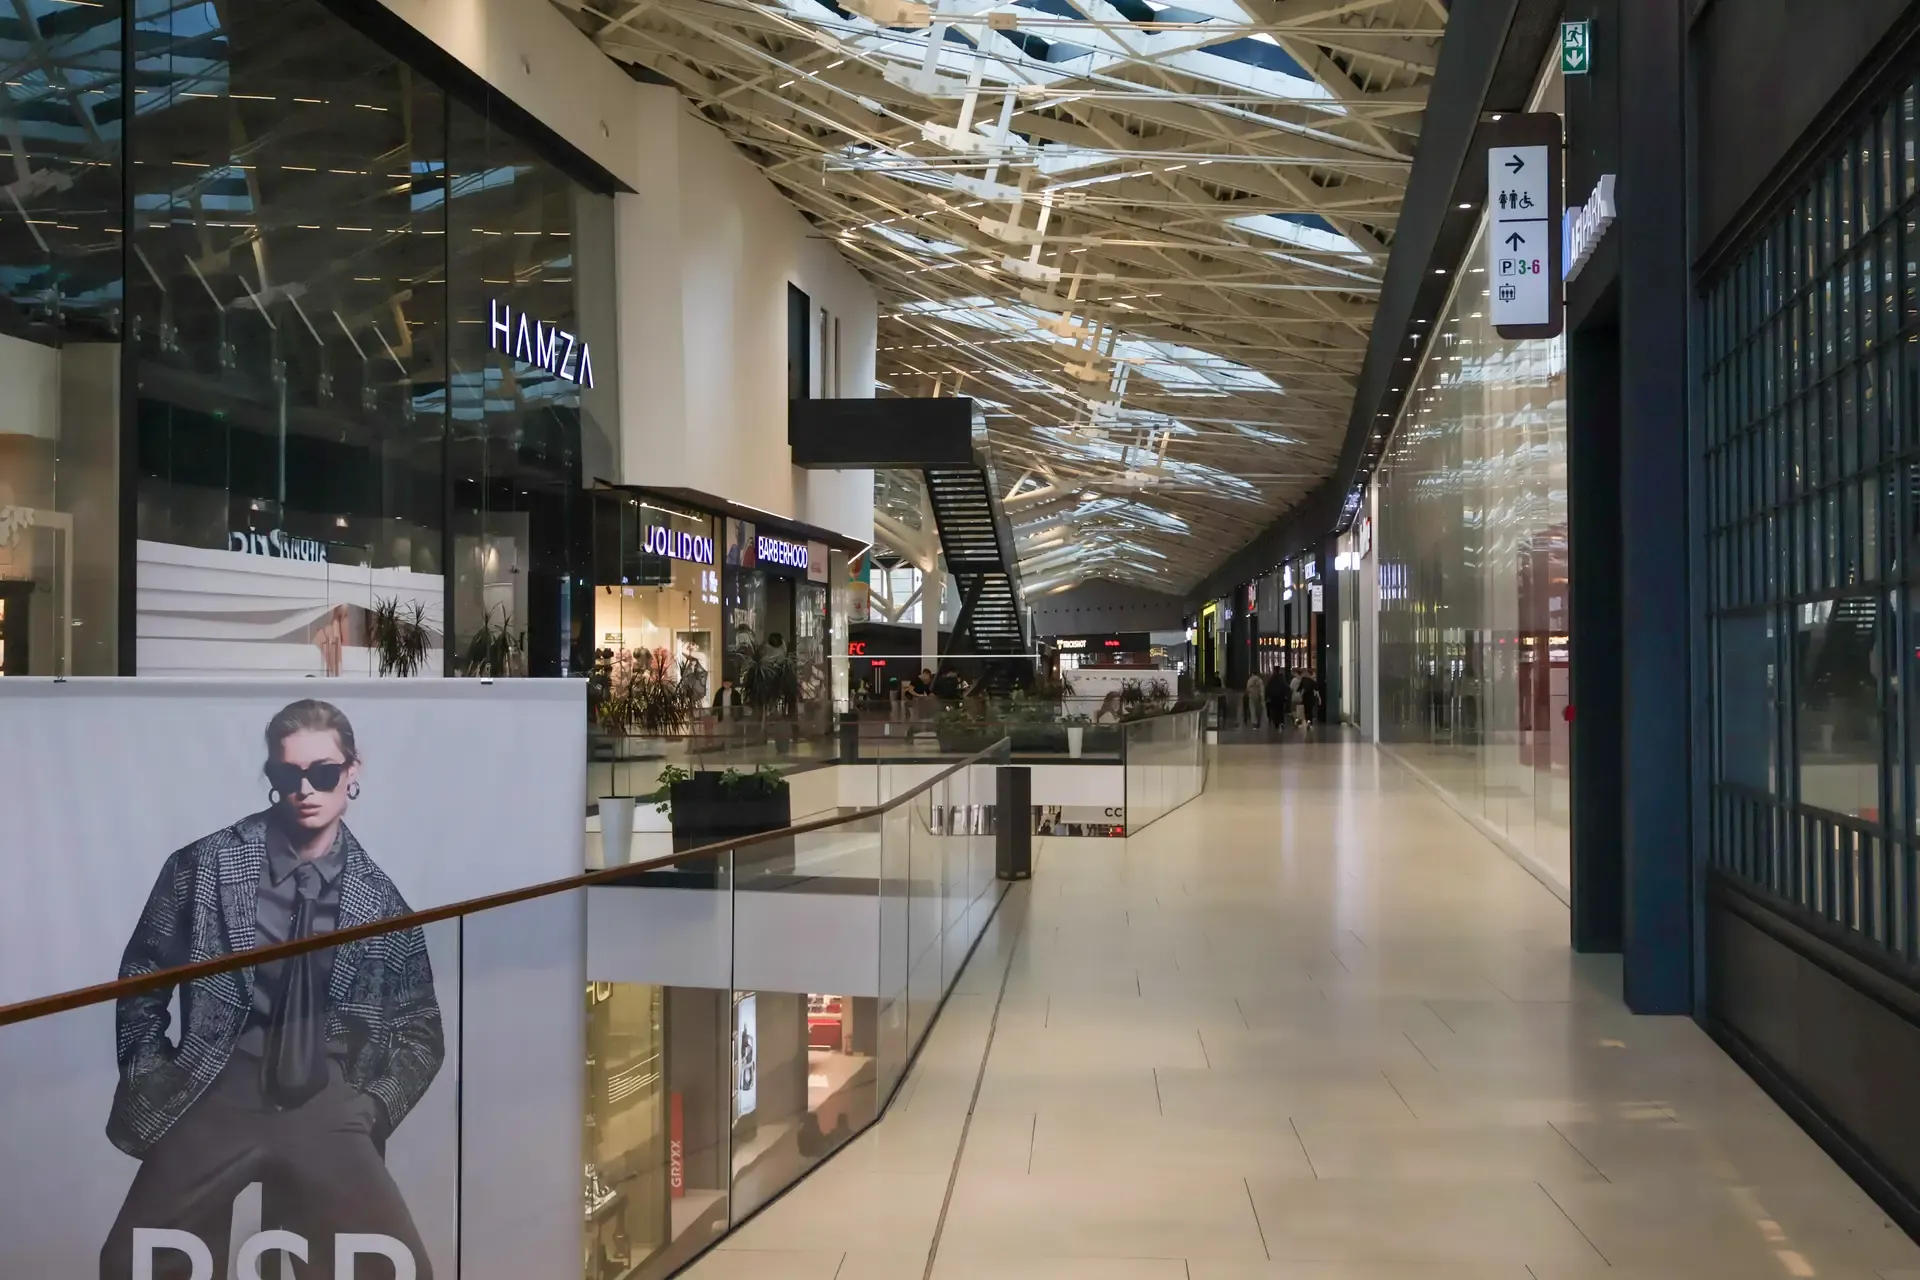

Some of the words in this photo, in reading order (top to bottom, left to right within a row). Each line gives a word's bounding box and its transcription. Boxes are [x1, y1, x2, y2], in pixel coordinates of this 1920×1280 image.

[1502, 261, 1512, 274] P
[1518, 259, 1541, 275] 3-6
[491, 298, 594, 389] HAMZA
[644, 525, 713, 565] JOLIDON
[758, 536, 808, 569] BARBERHOOD
[848, 642, 866, 656] FC
[670, 1140, 682, 1188] GRYXX
